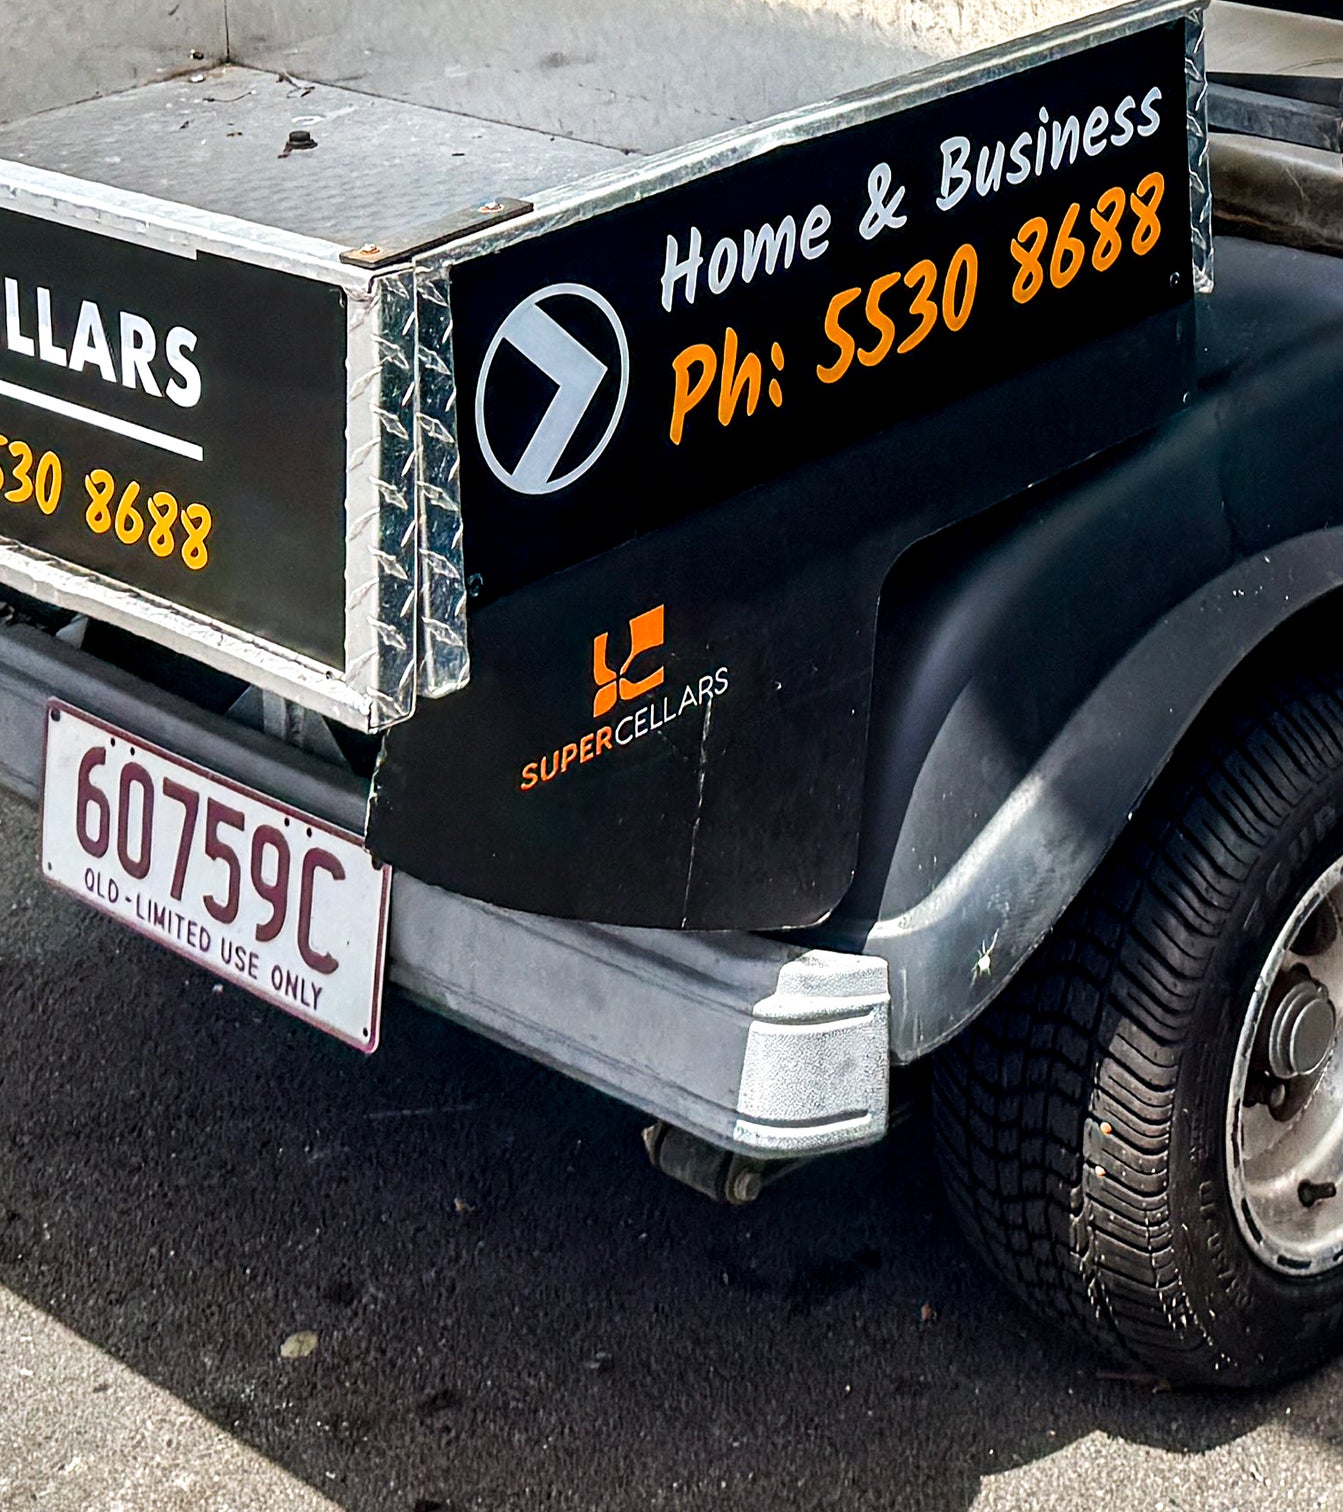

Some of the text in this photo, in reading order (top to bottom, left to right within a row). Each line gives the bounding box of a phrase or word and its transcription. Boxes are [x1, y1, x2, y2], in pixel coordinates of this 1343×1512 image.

[661, 86, 1163, 313] Home & Business
[668, 172, 1166, 445] Ph: 5530 8688
[85, 467, 212, 571] 8688
[520, 667, 729, 792] SUPERCELLARS
[75, 745, 347, 975] 60759C
[221, 936, 260, 979] USE
[271, 964, 324, 1011] ONLY
